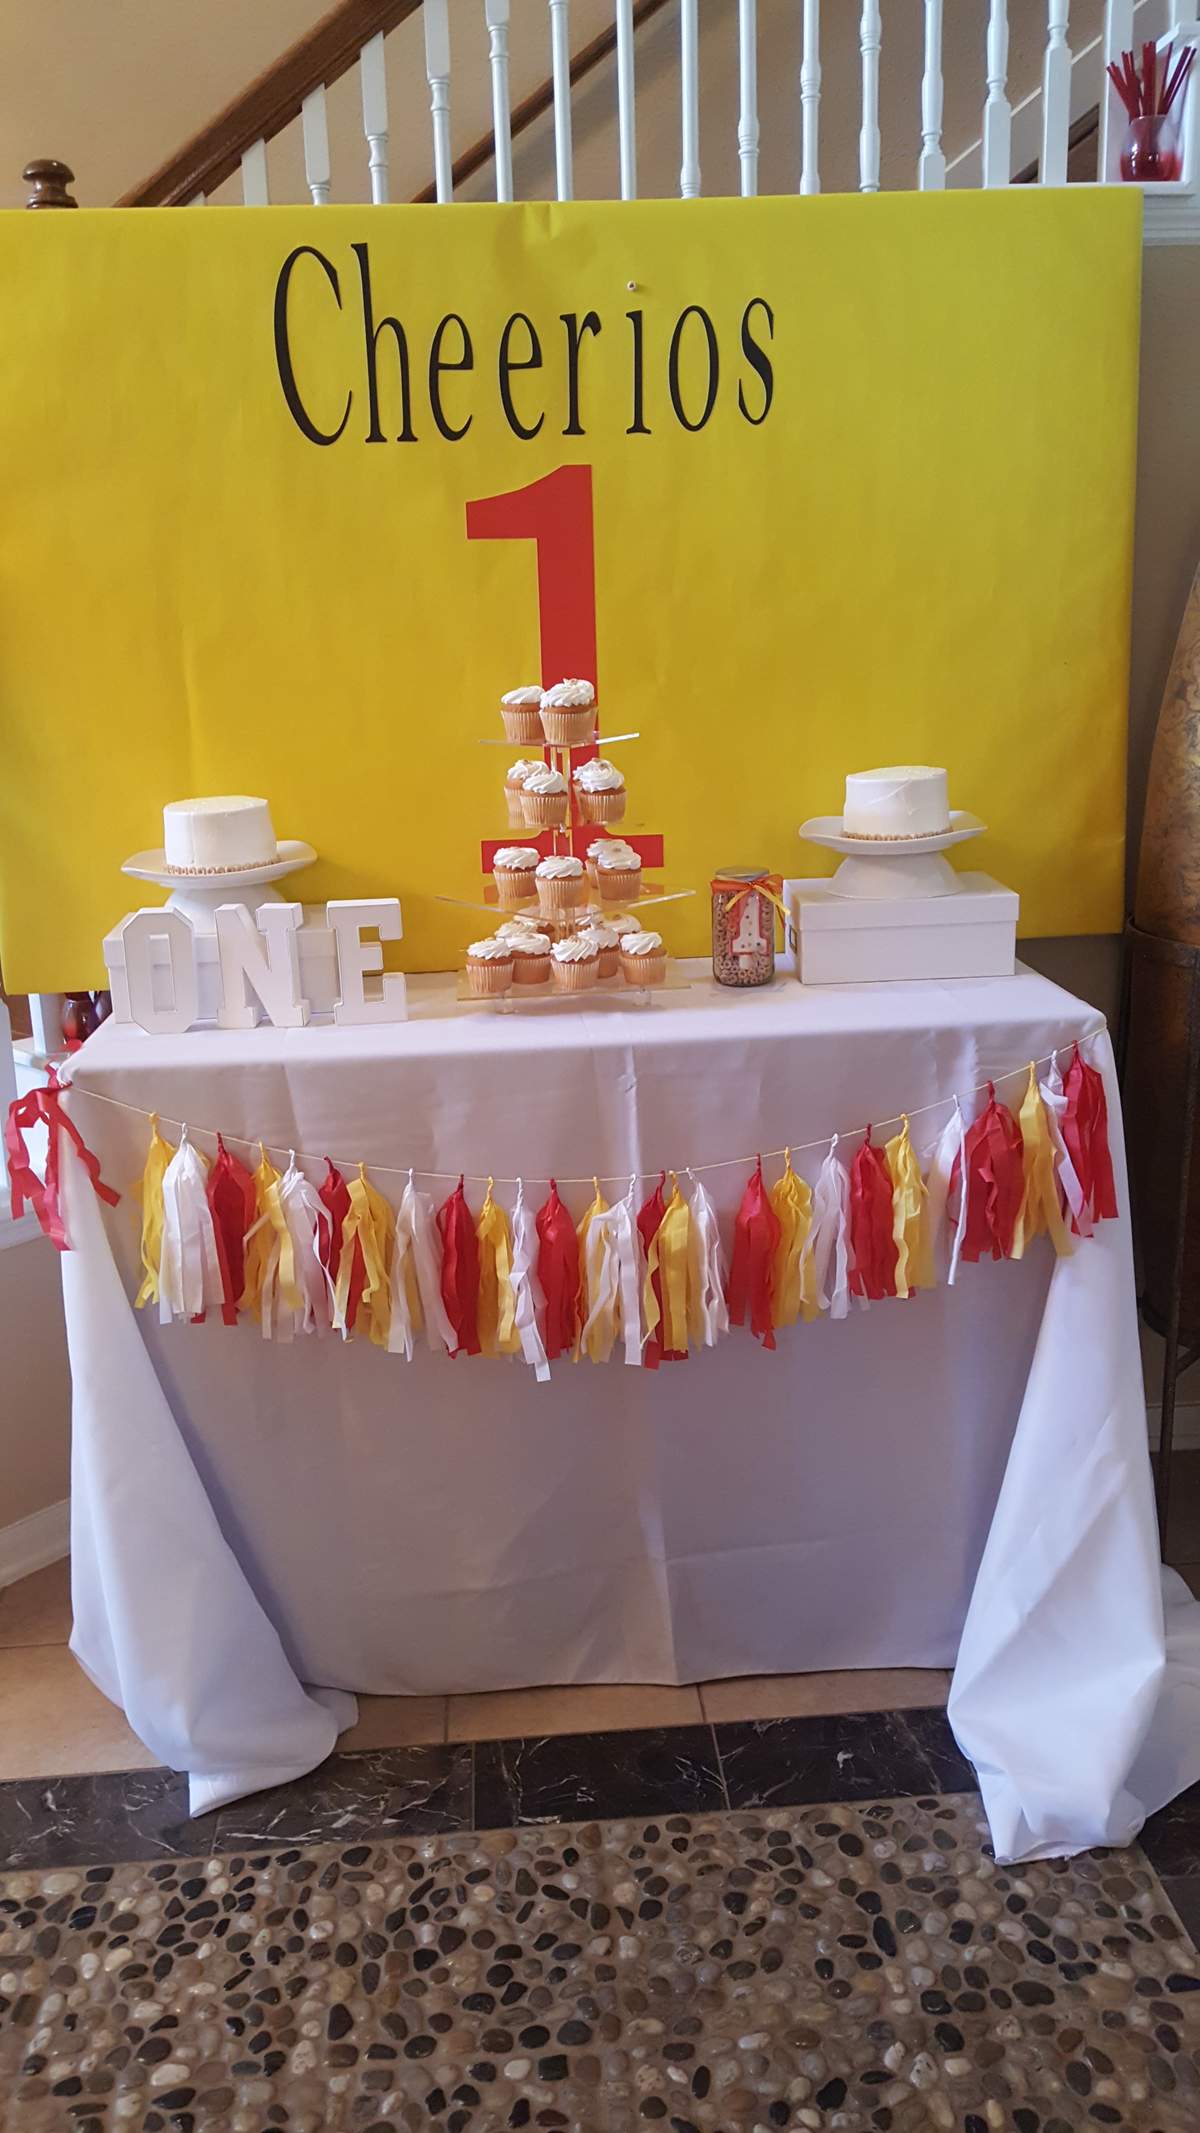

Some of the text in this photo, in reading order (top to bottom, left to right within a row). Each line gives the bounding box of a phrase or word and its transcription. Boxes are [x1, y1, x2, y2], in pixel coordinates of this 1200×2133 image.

[273, 242, 775, 446] Cheerios
[465, 464, 664, 874] 1
[122, 898, 409, 1035] ONE
